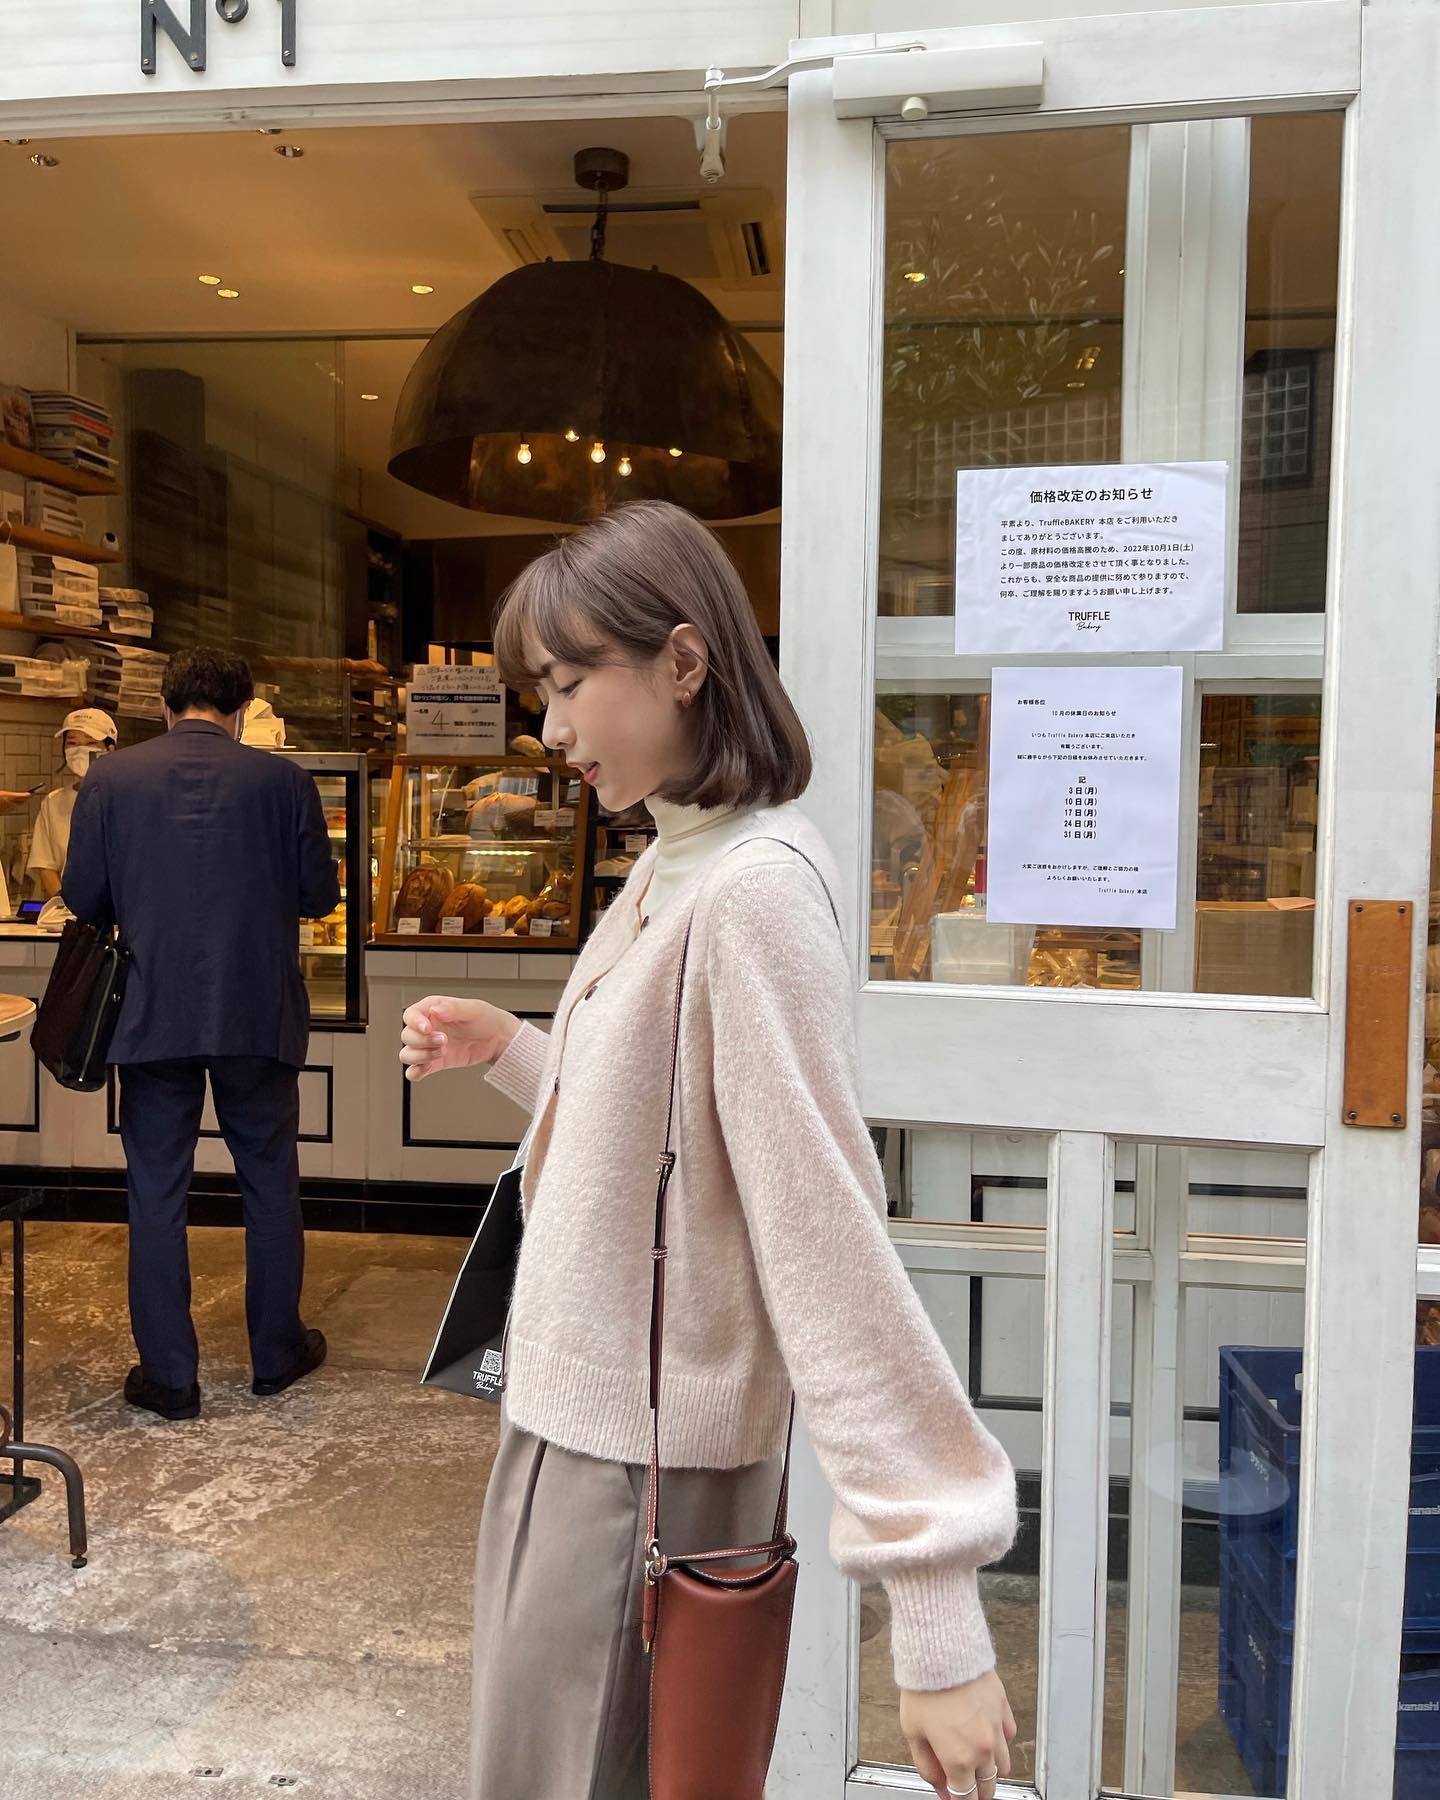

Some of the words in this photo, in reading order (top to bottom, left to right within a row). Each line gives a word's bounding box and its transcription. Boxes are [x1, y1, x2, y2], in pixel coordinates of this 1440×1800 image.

[1029, 487, 1154, 504] 価格改定のお知らせ
[1098, 517, 1114, 526] 本店
[1116, 515, 1178, 525] をご利用いただき
[1000, 532, 1105, 542] ましてありがとうございます。
[1000, 558, 1190, 570] より一部商品の価格改定をさせて頂く事となりました。
[1000, 572, 1190, 584] これからも、安全な商品の提供に努めて参りますので、
[1000, 587, 1174, 598] 何卒、ご理解を賜りますようお願い申し上げます。
[1068, 611, 1111, 622] TRUFFLE
[1075, 621, 1102, 633] Bakery
[432, 710, 449, 730] 4
[1078, 776, 1087, 784] 記
[473, 1371, 502, 1386] TRUFFLE
